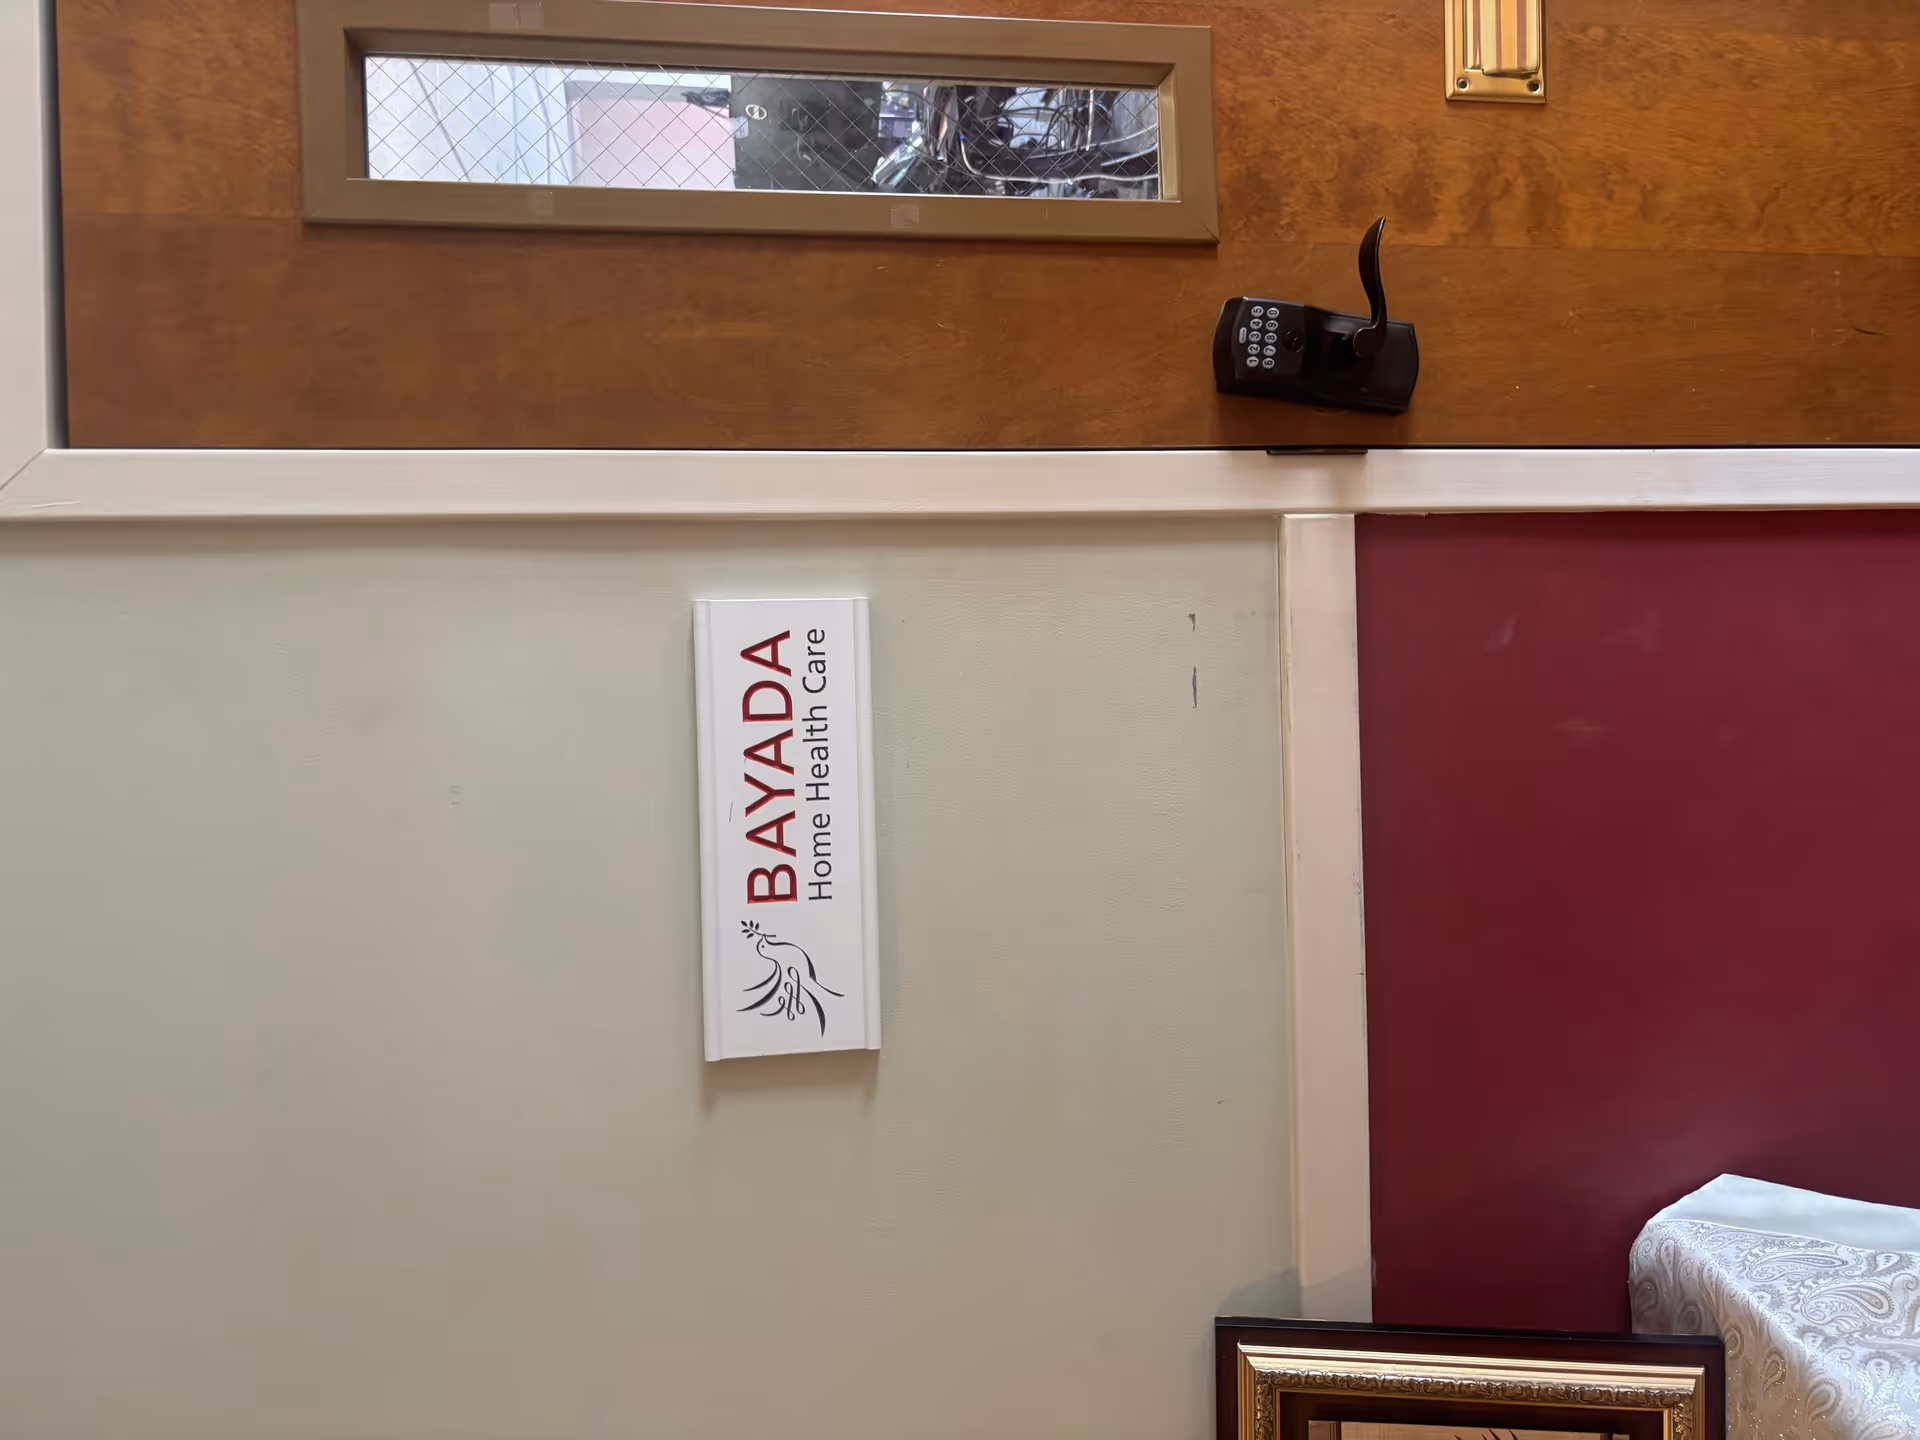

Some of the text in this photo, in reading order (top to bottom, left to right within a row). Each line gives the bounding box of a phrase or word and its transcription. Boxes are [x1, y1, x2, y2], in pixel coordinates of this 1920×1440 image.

[740, 629, 798, 904] BAYADA
[802, 628, 833, 901] Home Health Care
